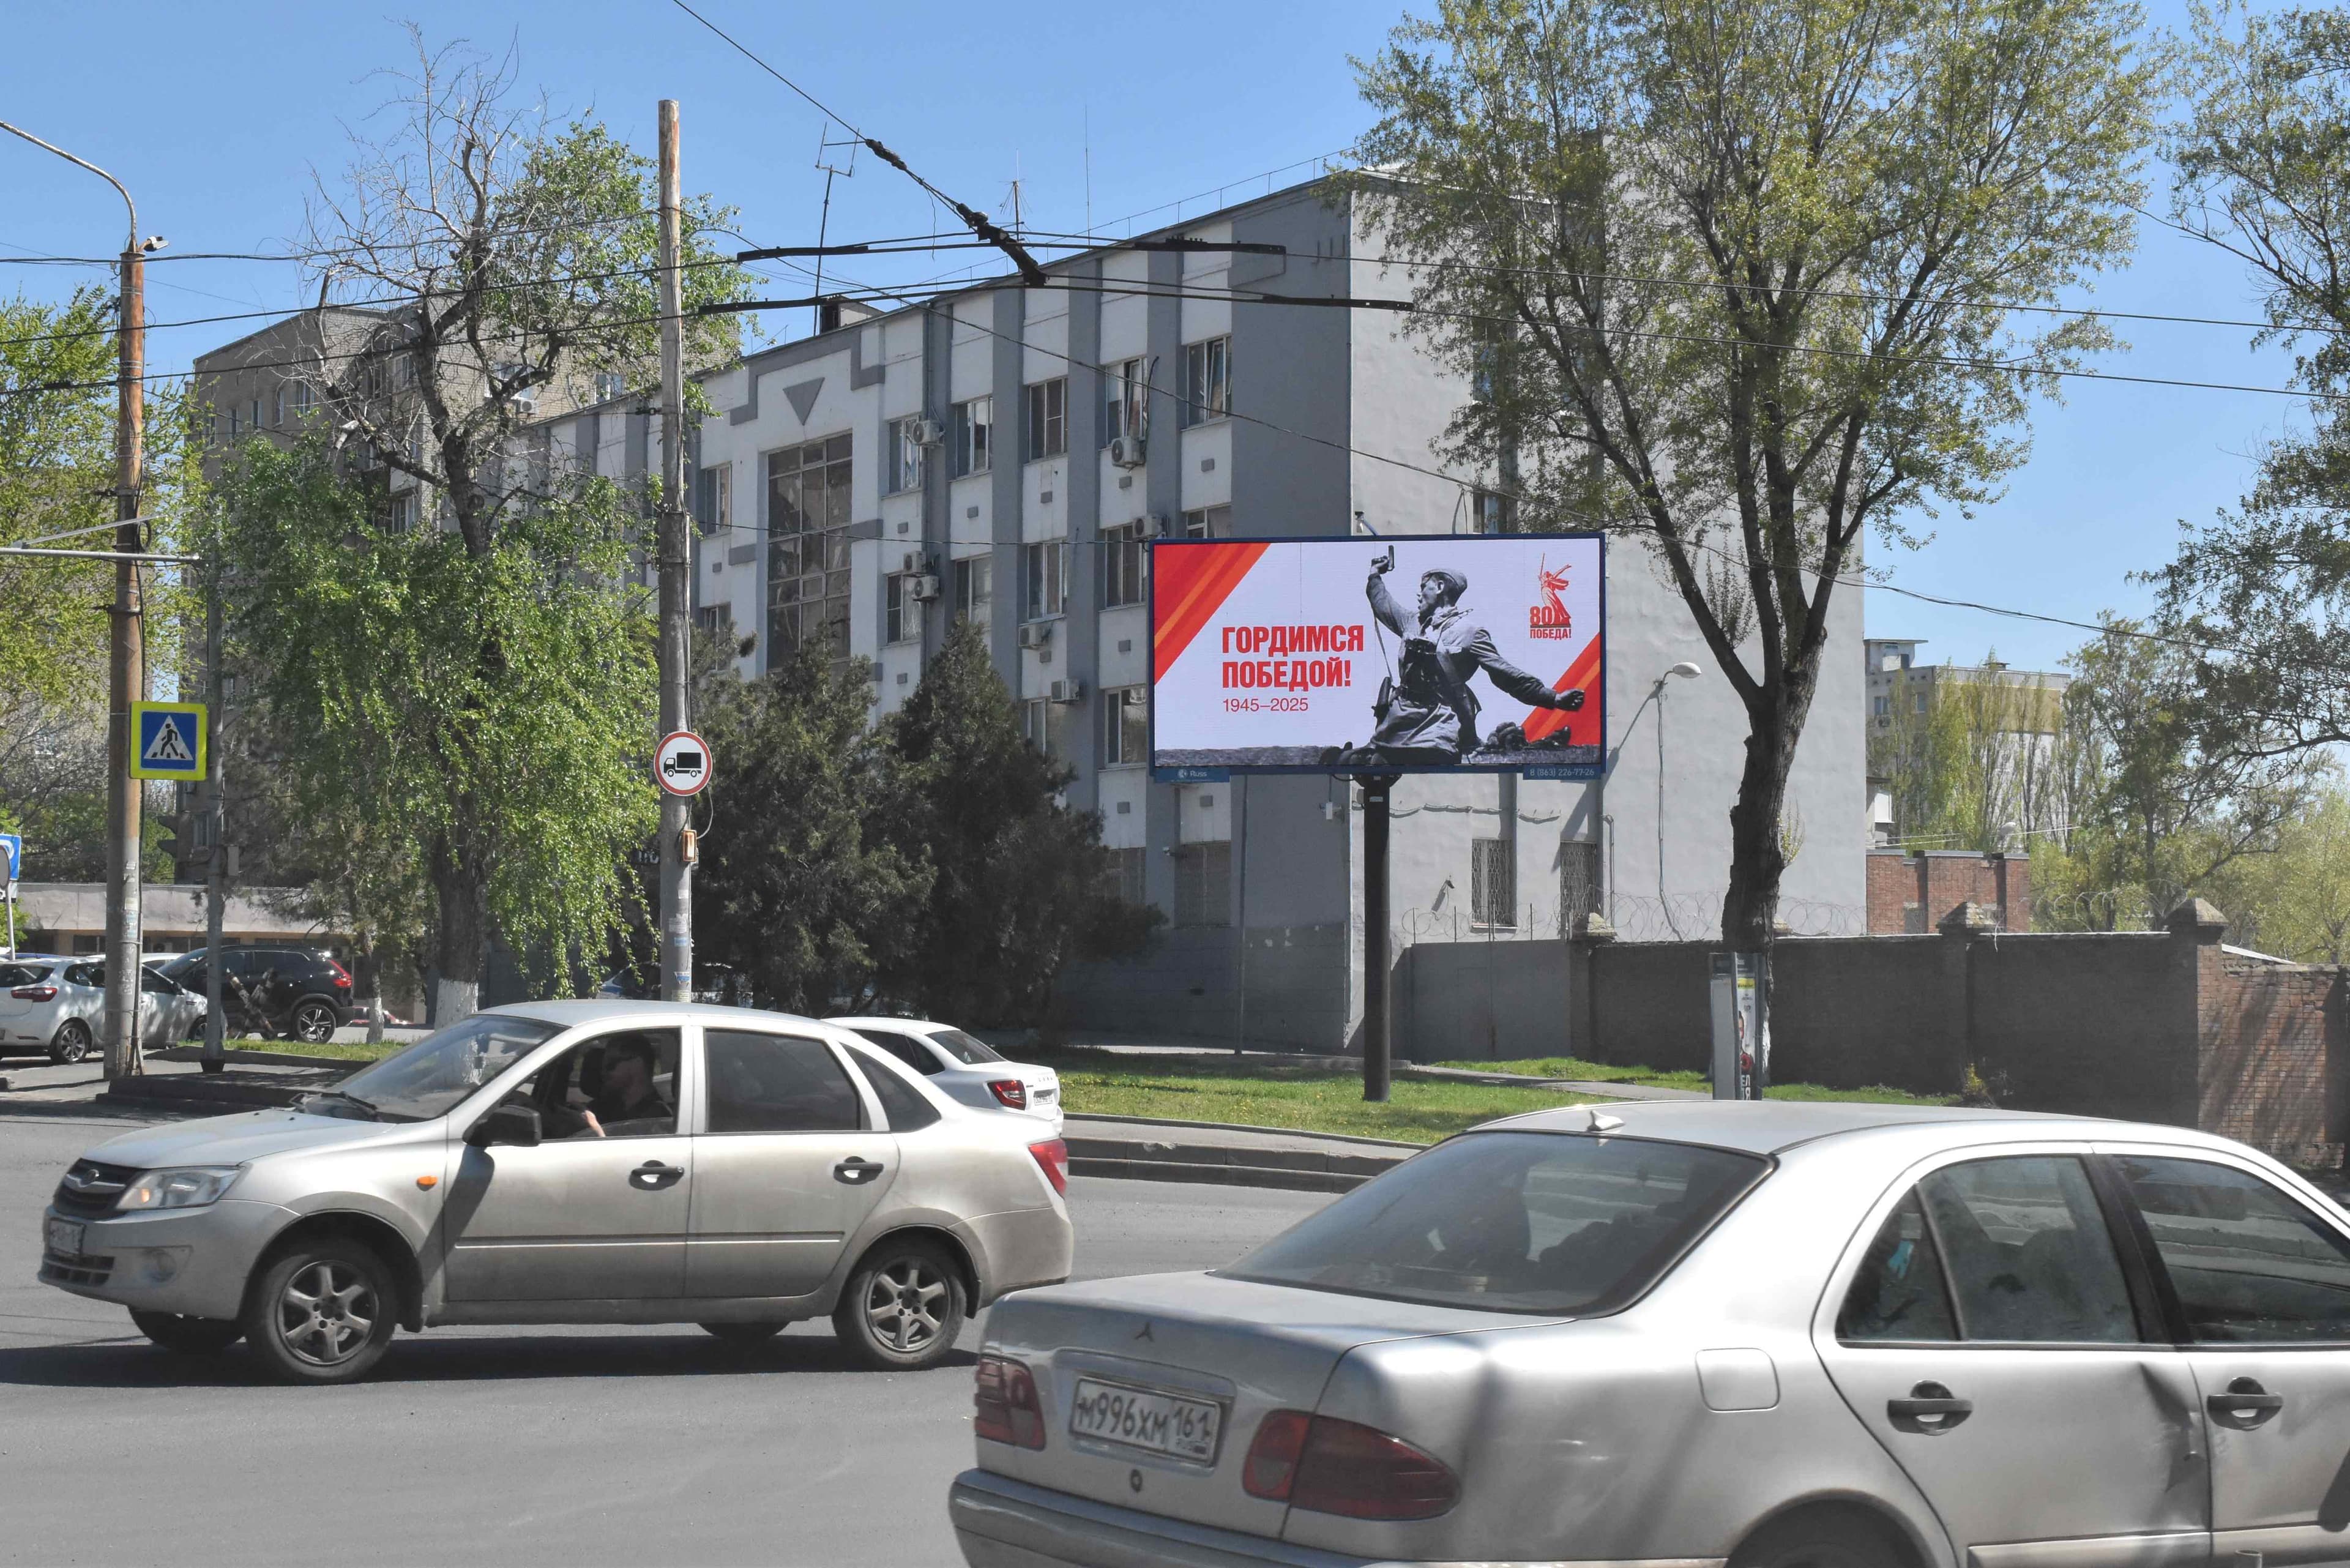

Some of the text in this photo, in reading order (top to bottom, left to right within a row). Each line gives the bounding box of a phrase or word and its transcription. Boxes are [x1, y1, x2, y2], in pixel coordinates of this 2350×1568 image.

[1530, 606, 1553, 625] 80
[1222, 625, 1363, 657] ГОРДИМСЯ
[1530, 629, 1572, 640] ПОБЕДА!
[1222, 657, 1351, 692] ПОБЕДОЙ!
[1537, 768, 1556, 777] (863)
[1173, 1406, 1209, 1440] 161
